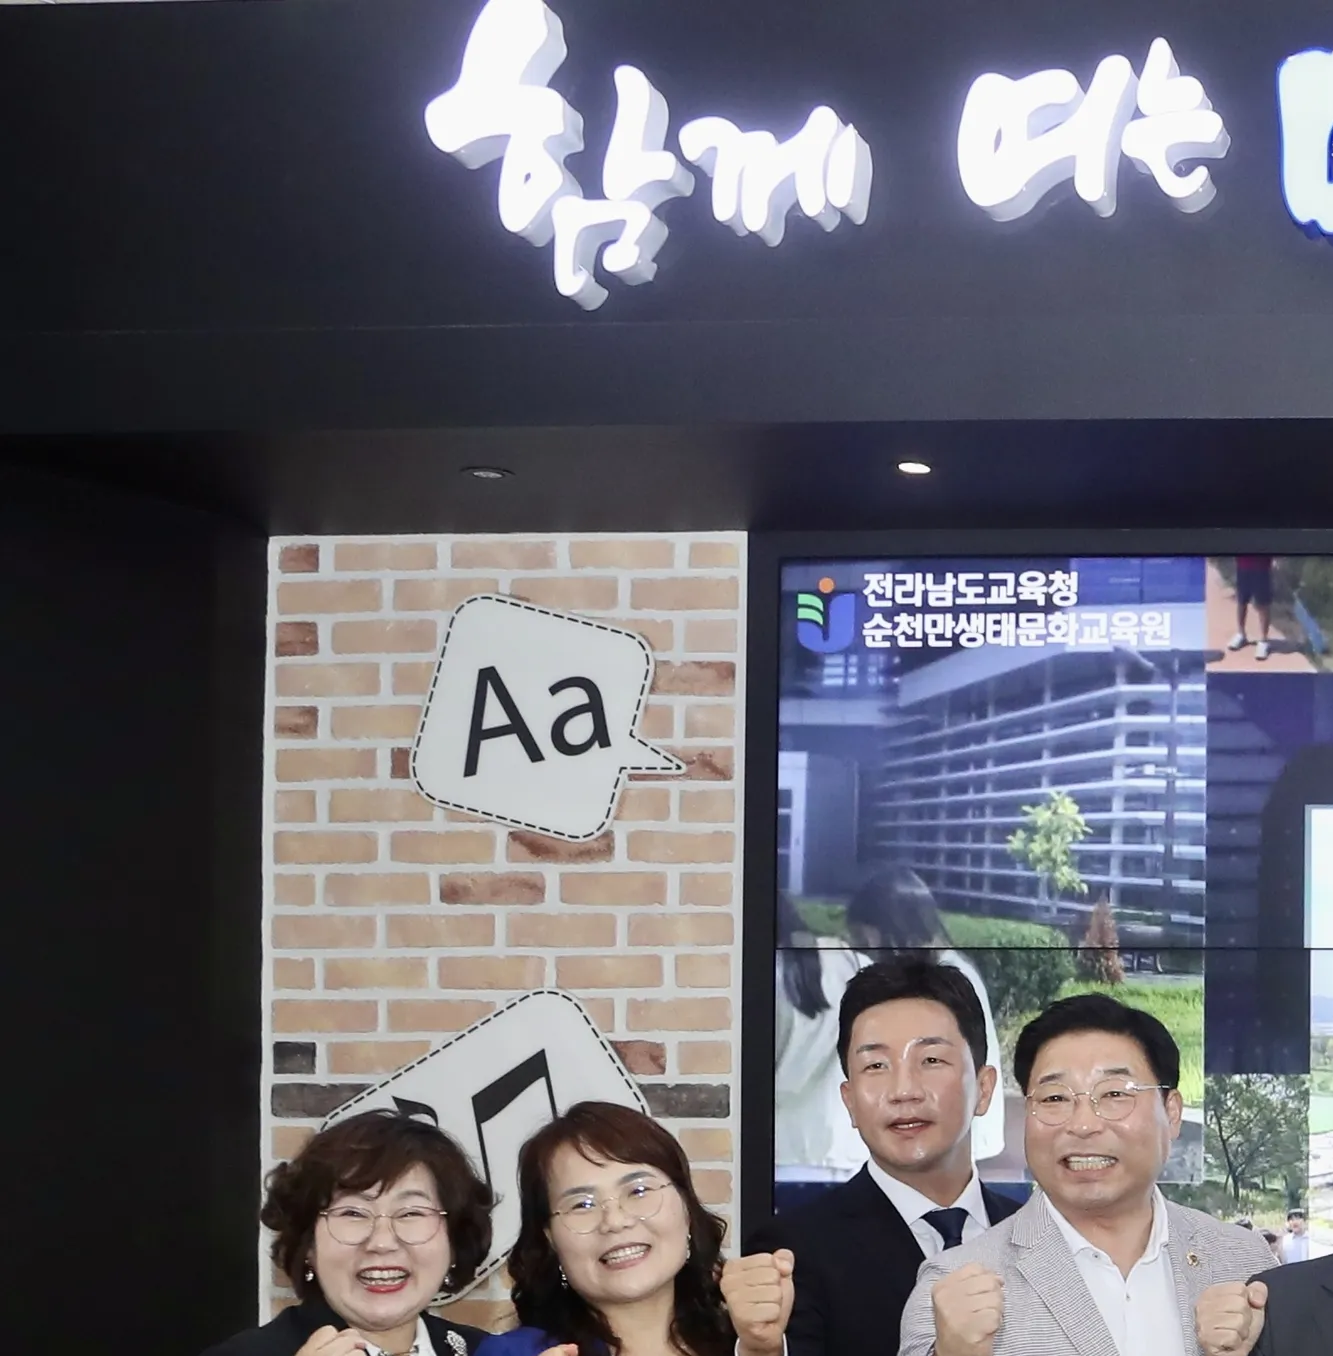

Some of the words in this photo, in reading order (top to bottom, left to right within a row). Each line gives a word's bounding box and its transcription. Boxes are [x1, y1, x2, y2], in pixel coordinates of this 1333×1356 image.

[423, 0, 872, 308] 함께
[956, 37, 1230, 218] 여는
[861, 570, 1079, 608] 전라남도교육청
[861, 611, 1171, 648] 순천만생태문화교육원
[462, 664, 613, 778] Aa
